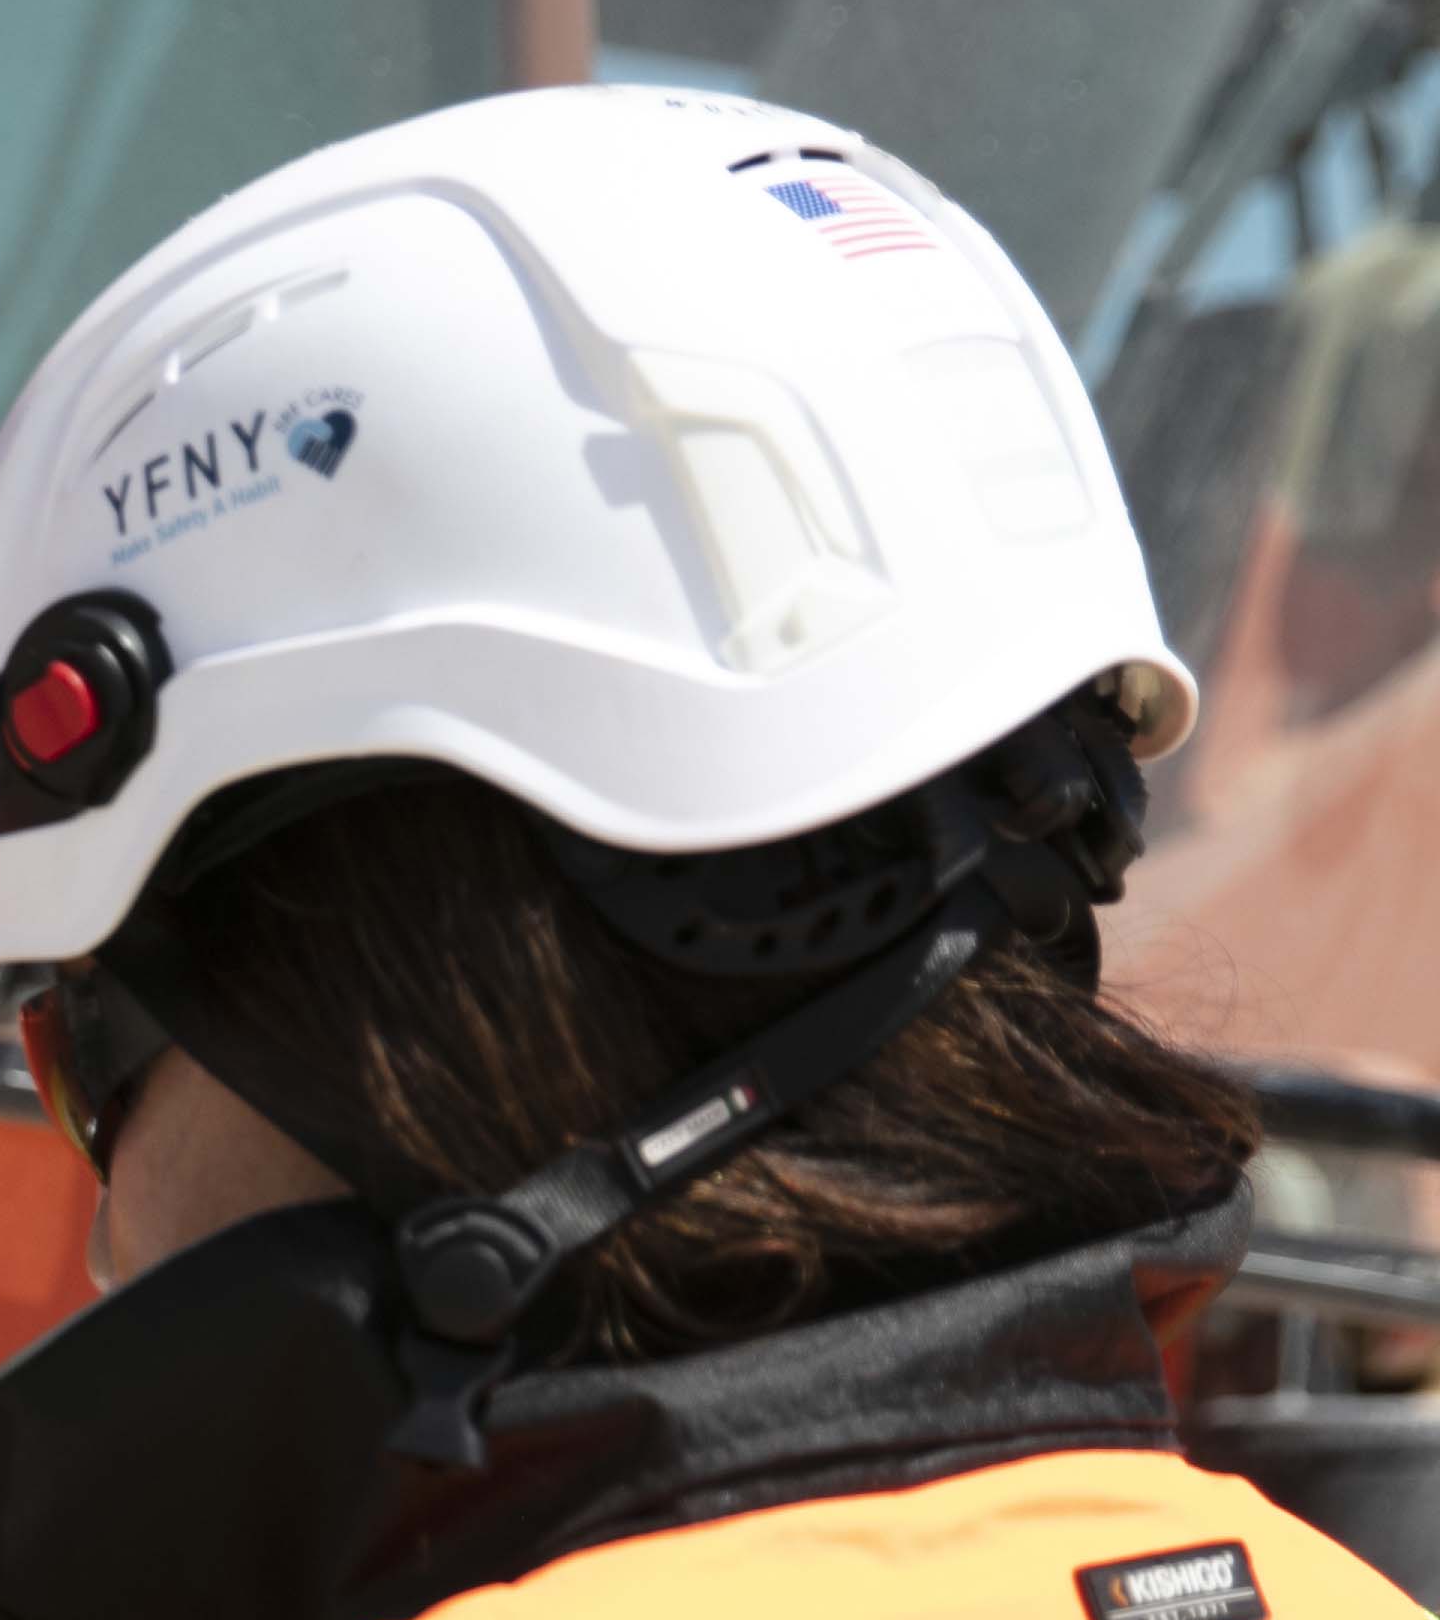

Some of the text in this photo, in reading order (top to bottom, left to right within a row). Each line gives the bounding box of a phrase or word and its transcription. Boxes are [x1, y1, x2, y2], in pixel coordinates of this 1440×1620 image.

[102, 409, 265, 536] YFNY
[155, 508, 209, 545] Safety
[1127, 1554, 1233, 1604] KISHIGO
